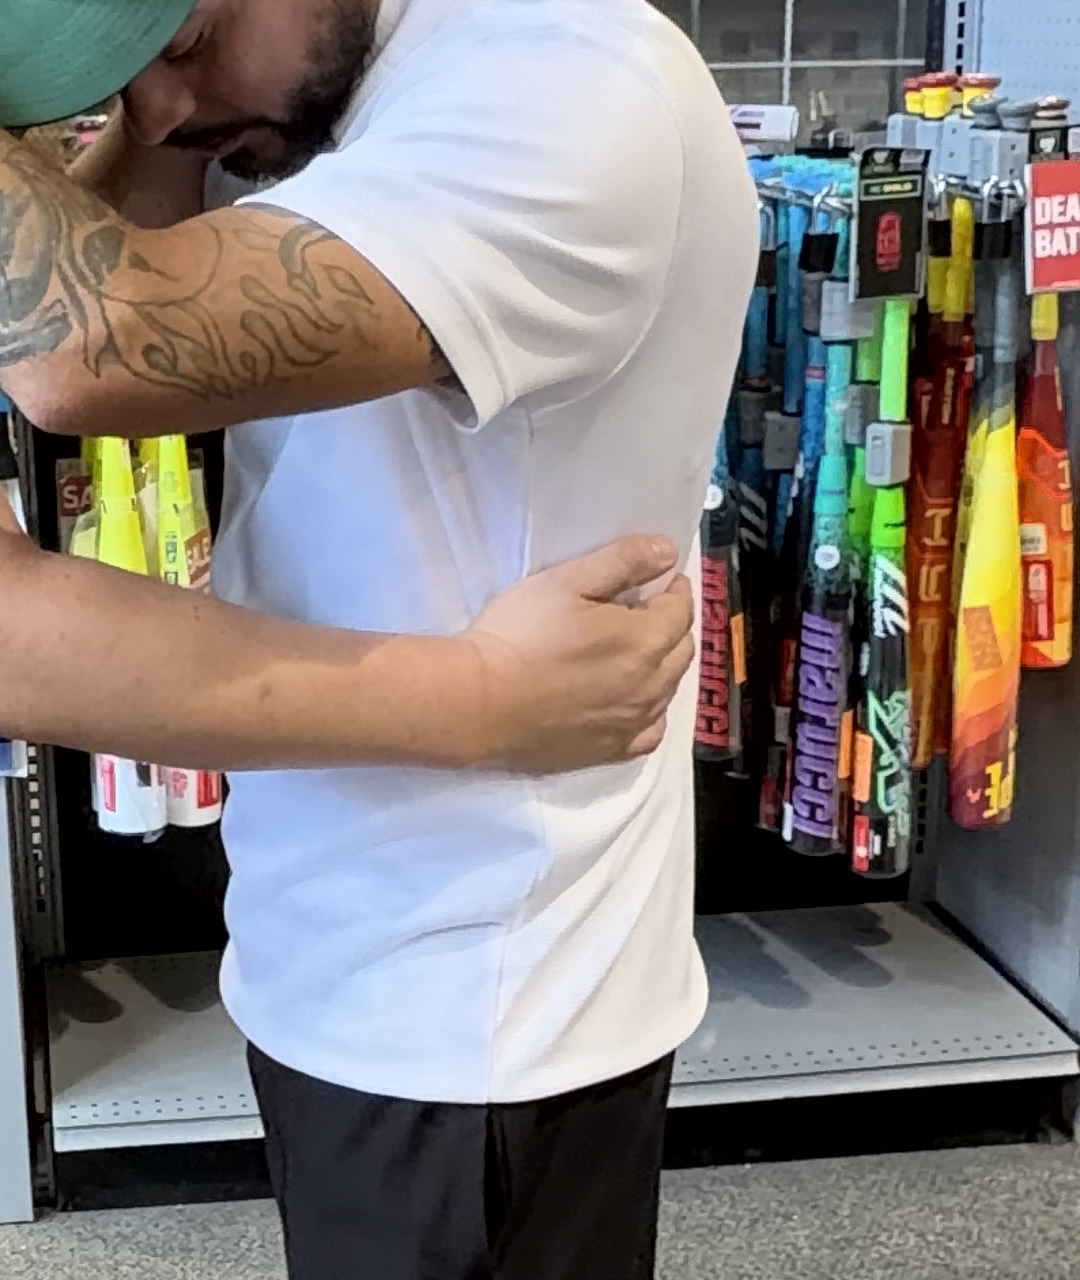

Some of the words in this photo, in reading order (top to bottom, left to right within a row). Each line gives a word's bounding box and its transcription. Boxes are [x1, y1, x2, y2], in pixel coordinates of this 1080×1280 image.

[62, 484, 93, 509] SA
[697, 556, 729, 746] marucci
[792, 610, 843, 838] marucci
